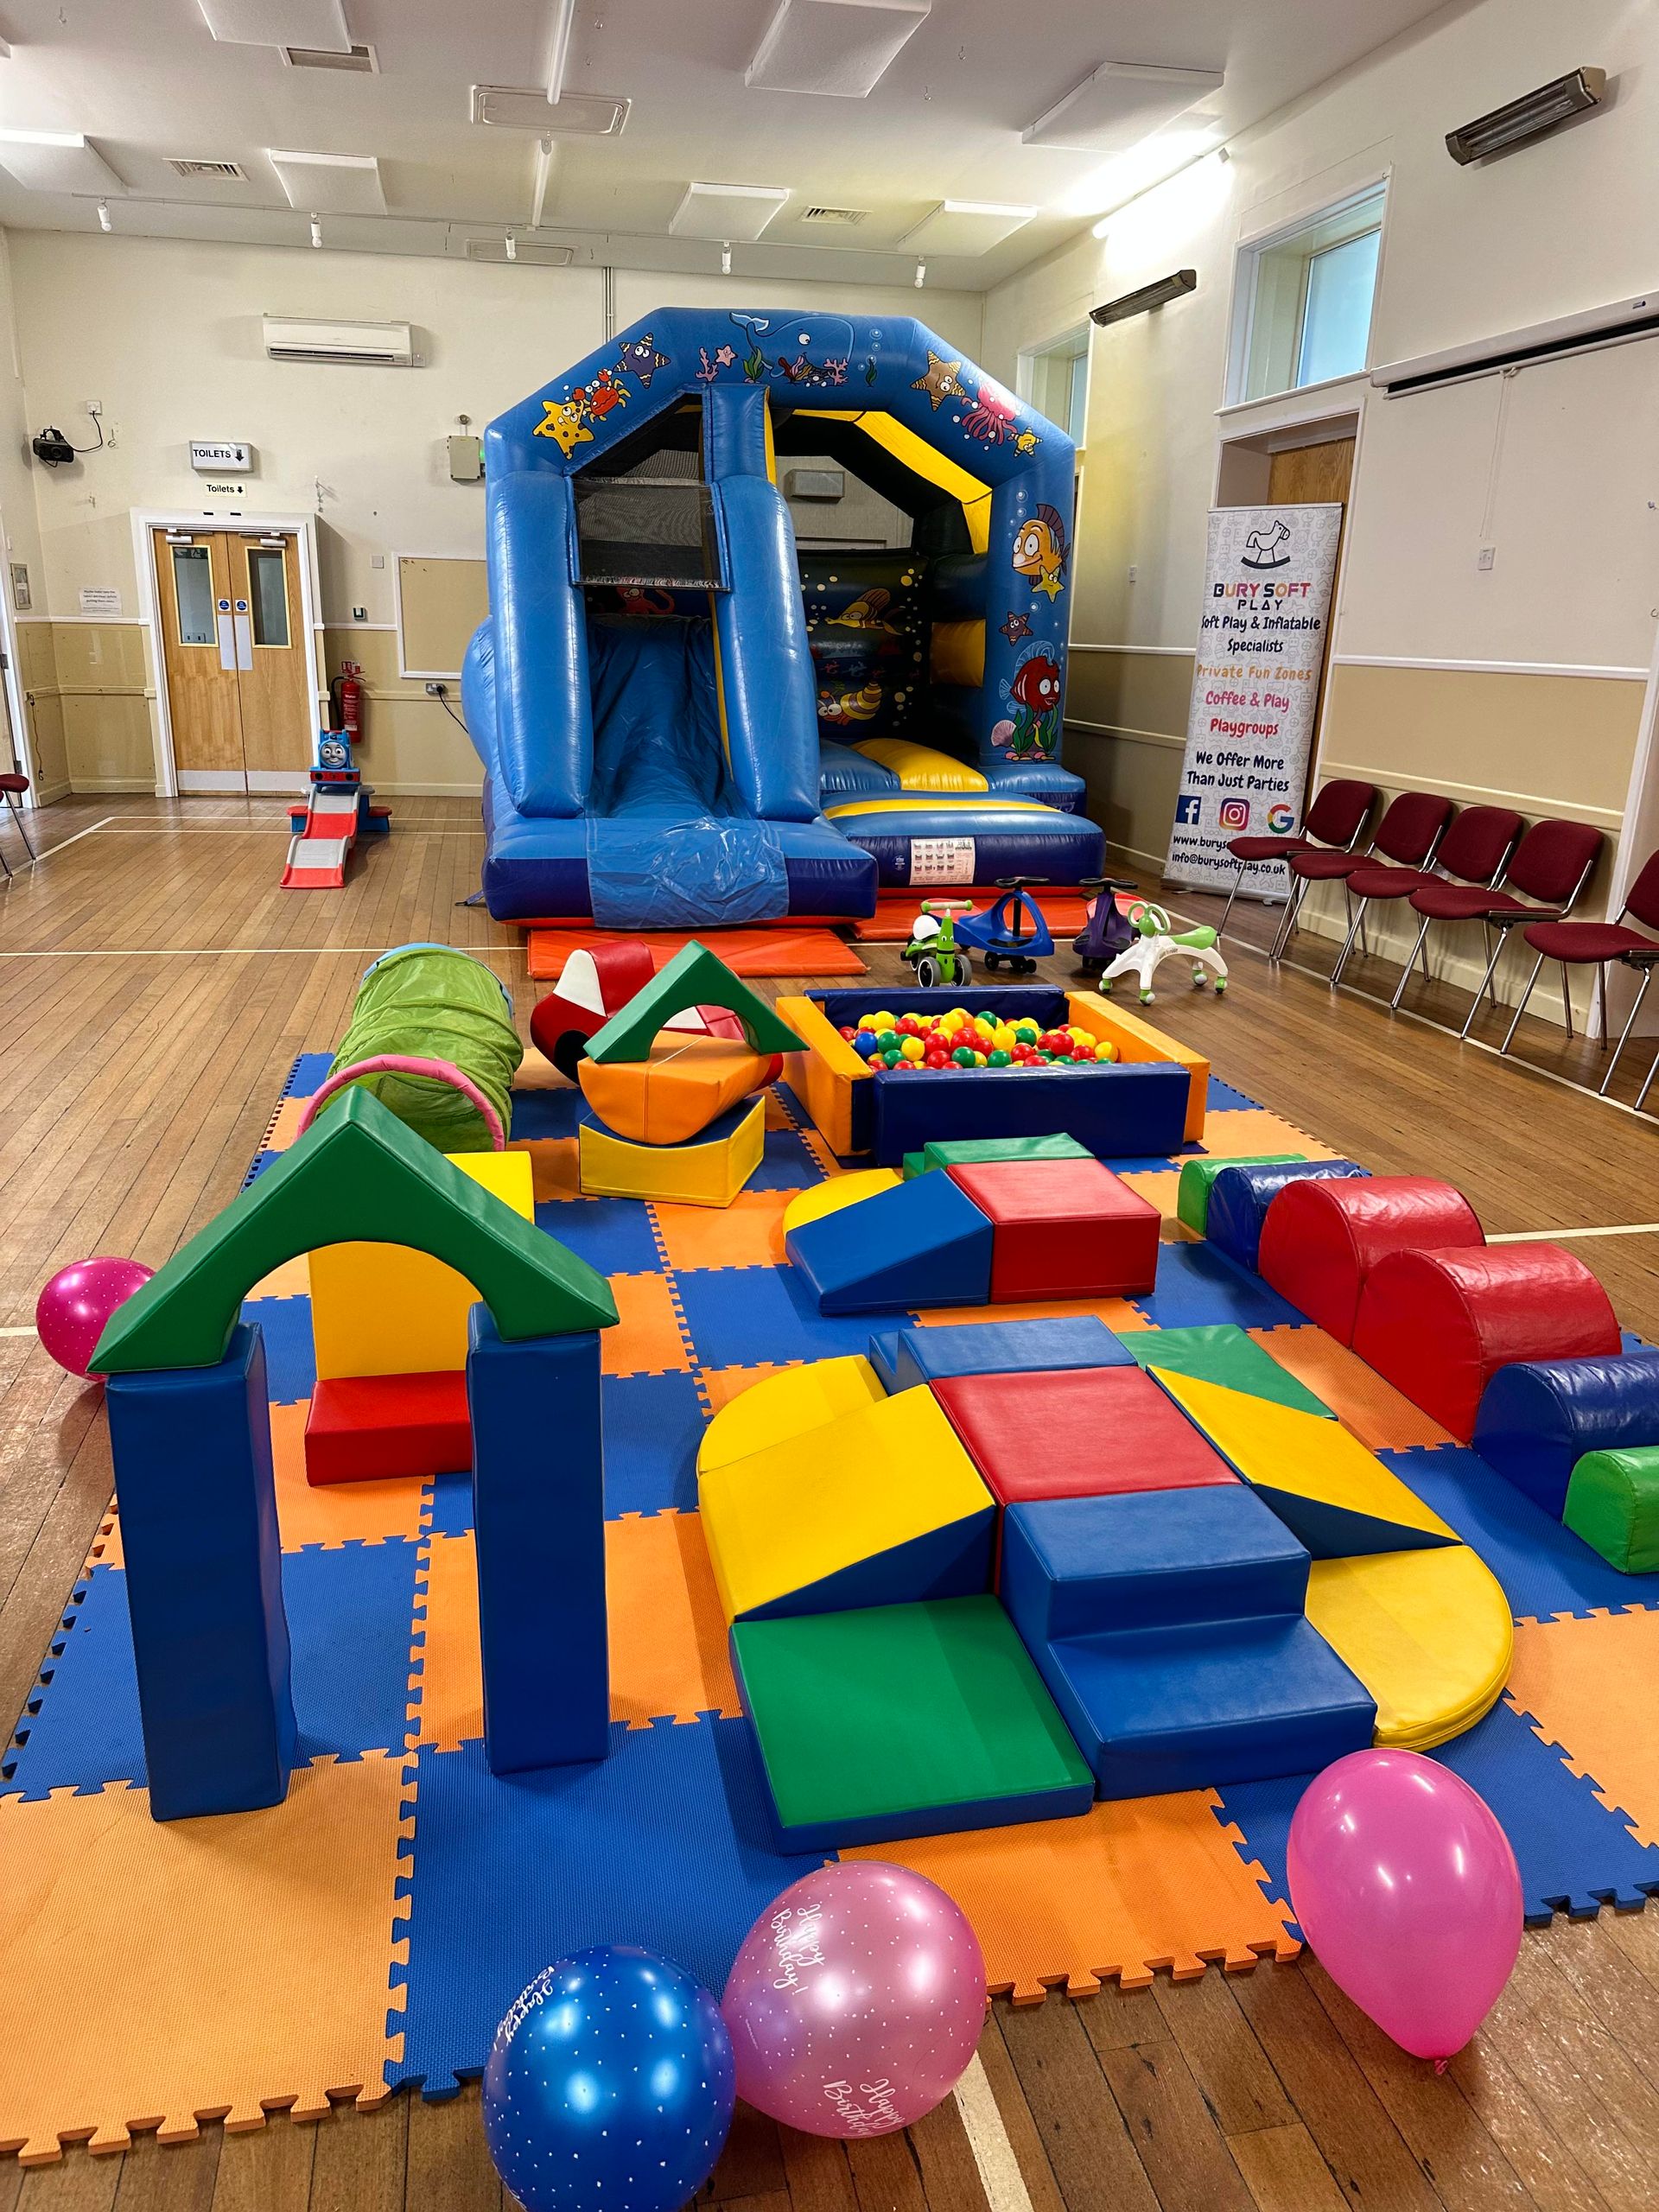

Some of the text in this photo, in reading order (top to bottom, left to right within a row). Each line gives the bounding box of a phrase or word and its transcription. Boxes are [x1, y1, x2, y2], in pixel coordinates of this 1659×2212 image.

[193, 449, 232, 458] TOILETS
[206, 484, 235, 493] Toilets
[1213, 582, 1311, 598] BURY SOFT
[1237, 599, 1283, 611] PLAY
[1222, 615, 1247, 632] Play
[1250, 616, 1260, 630] &
[1262, 616, 1321, 631] Inflatable
[1227, 638, 1284, 655] Specialists
[1197, 664, 1313, 681] Private Fun Zones
[1205, 690, 1290, 713] Coffee & Play
[1210, 718, 1280, 739] Playgroups
[1196, 751, 1285, 770] We Offer More
[1186, 771, 1290, 792] Than Just Parties
[1173, 835, 1231, 852] www.burys
[1172, 852, 1286, 875] info@burysoftpay.co.uk
